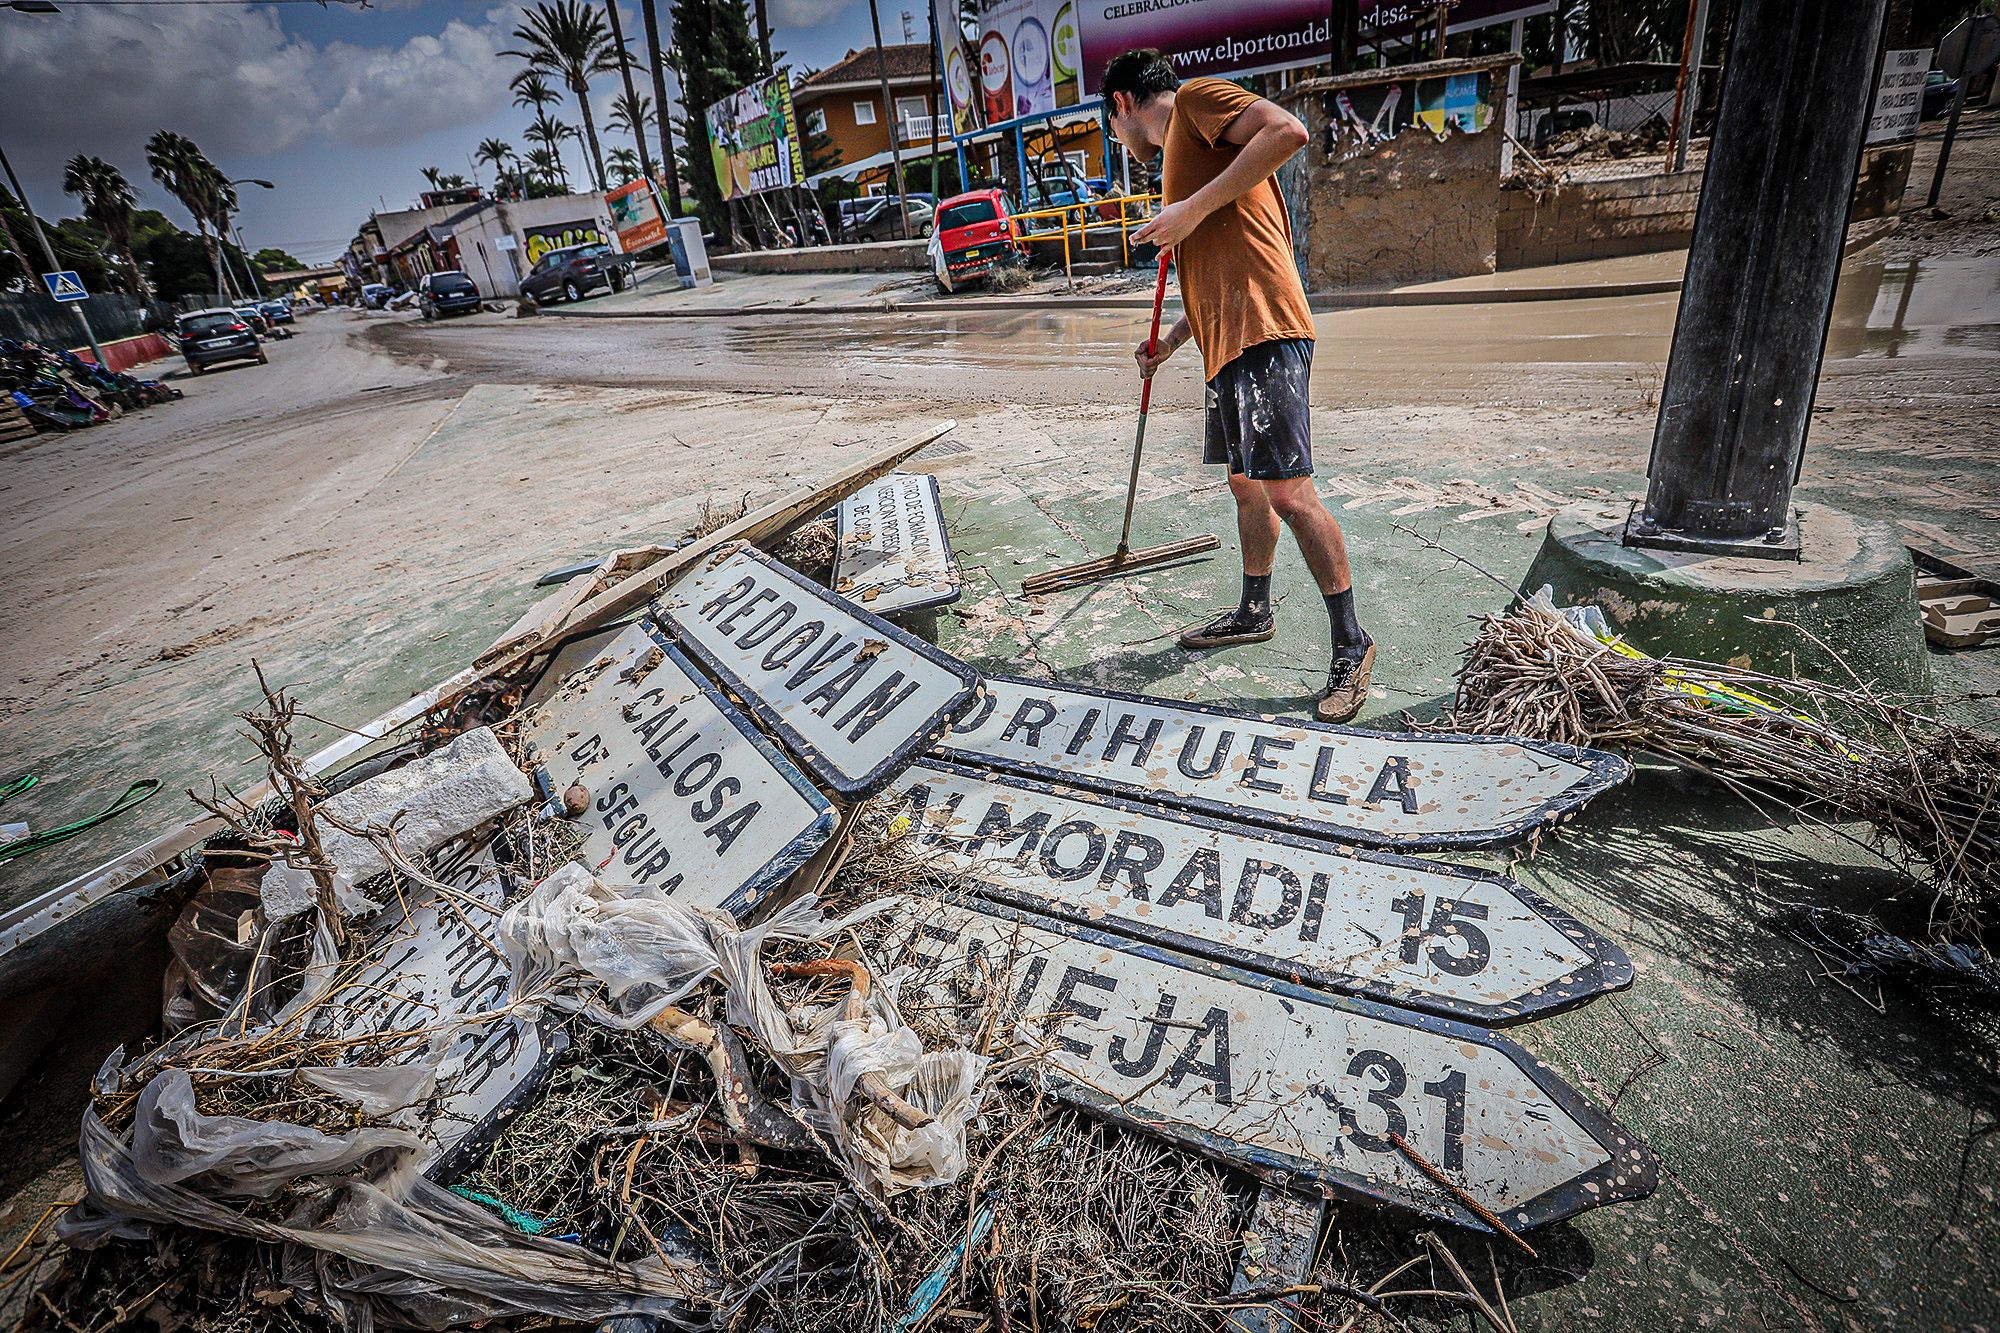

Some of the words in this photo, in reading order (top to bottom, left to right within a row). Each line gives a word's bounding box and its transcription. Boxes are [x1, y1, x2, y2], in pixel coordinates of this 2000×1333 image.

[853, 504, 870, 518] DE
[698, 575, 921, 745] REDOVAN
[571, 733, 610, 774] DE
[622, 688, 762, 857] CALLOSA
[597, 782, 684, 896] SEGURA
[1391, 891, 1490, 976] 15
[1339, 1049, 1467, 1171] 31
